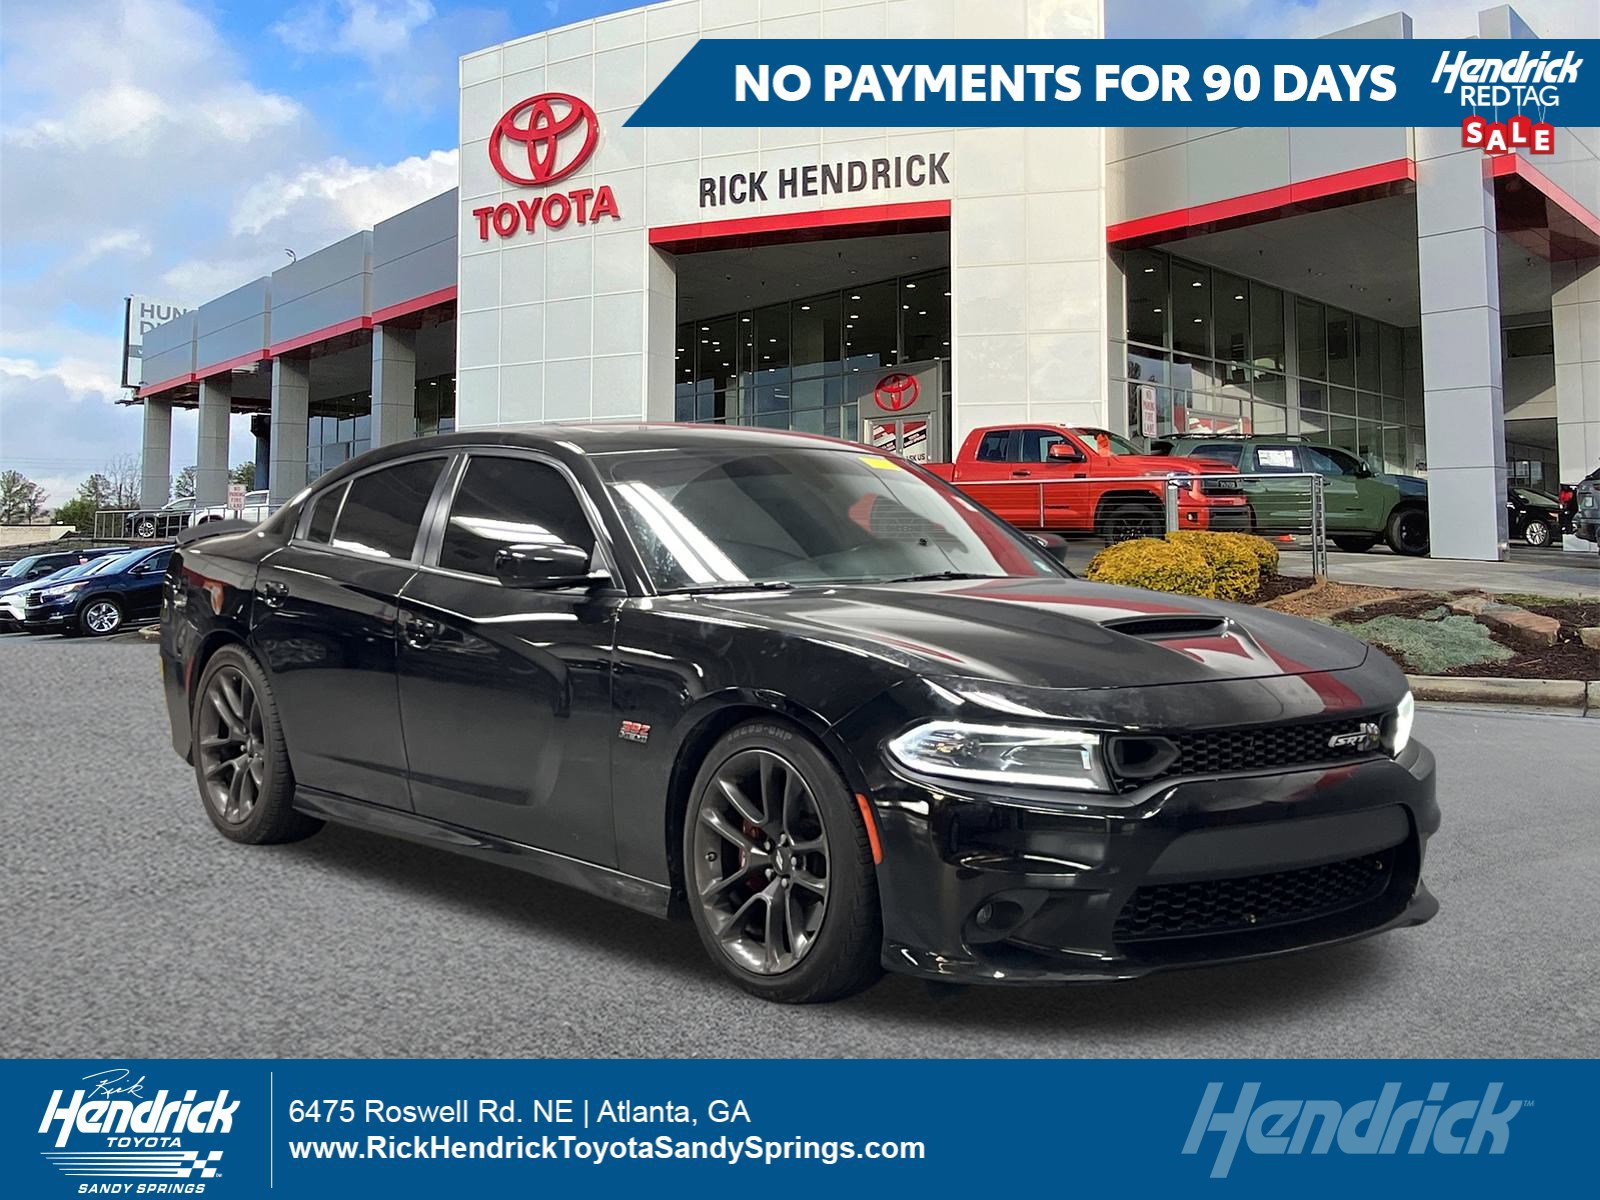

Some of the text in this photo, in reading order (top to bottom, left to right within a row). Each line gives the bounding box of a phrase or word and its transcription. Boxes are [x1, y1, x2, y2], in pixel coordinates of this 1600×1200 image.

[699, 152, 951, 208] RICK HENDRICK
[472, 185, 621, 241] TOYOTA
[622, 720, 651, 736] 392
[1334, 734, 1367, 747] SRT
